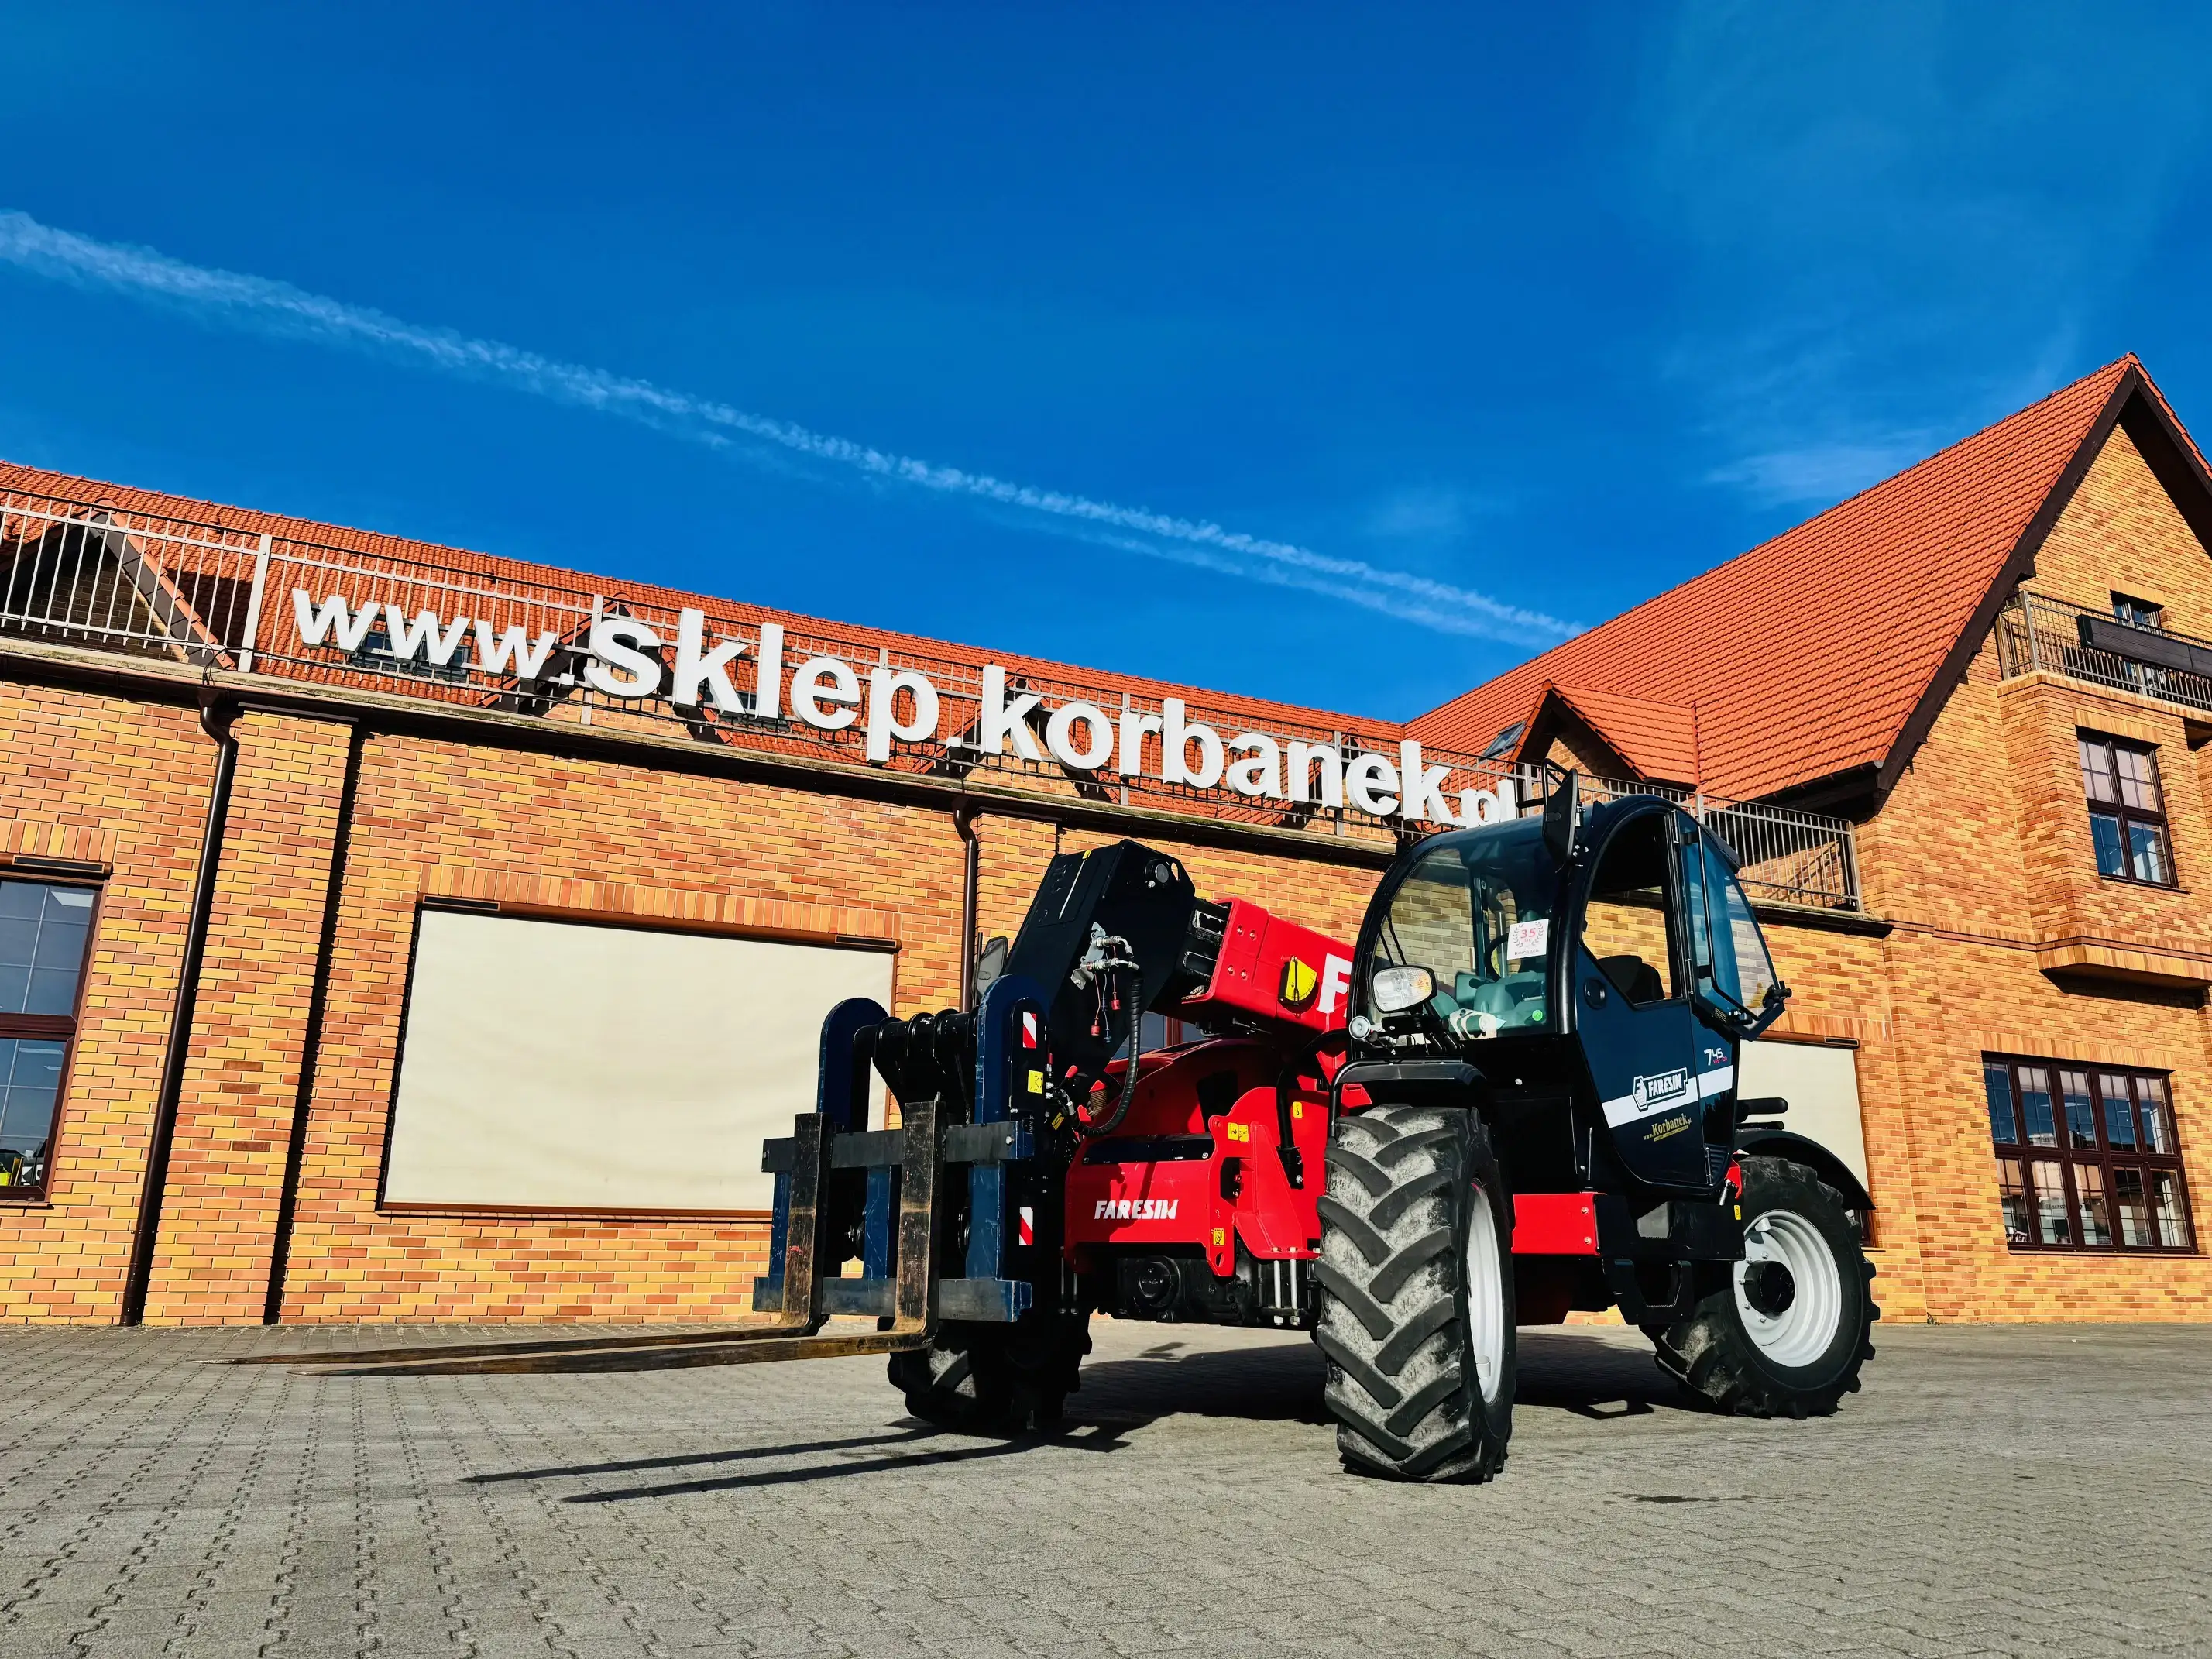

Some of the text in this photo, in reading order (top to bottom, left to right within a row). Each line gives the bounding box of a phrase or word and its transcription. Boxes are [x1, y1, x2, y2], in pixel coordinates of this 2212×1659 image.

[1520, 928, 1536, 938] 35
[1316, 953, 1352, 1018] F
[1647, 1073, 1682, 1097] FARESIN
[1094, 1199, 1179, 1220] FARESIN
